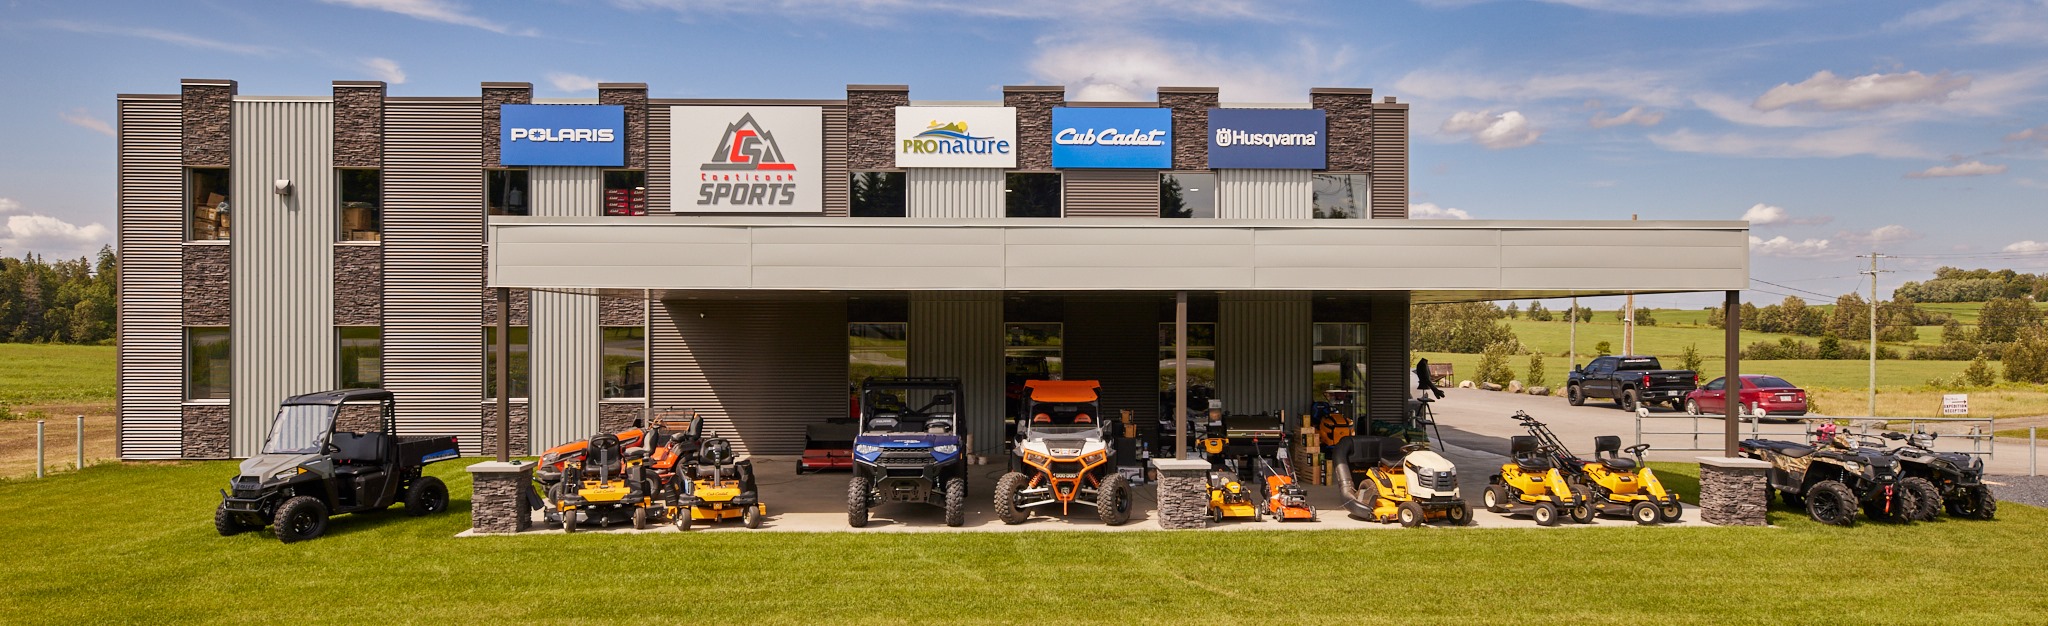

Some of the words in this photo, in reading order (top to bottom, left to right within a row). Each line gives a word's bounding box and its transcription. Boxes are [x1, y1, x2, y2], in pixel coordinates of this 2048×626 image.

[510, 128, 615, 142] POLARIS
[1055, 128, 1096, 145] Cub
[1232, 130, 1316, 148] Husqvarna
[701, 172, 794, 182] Coaticook
[697, 183, 797, 205] SPORTS
